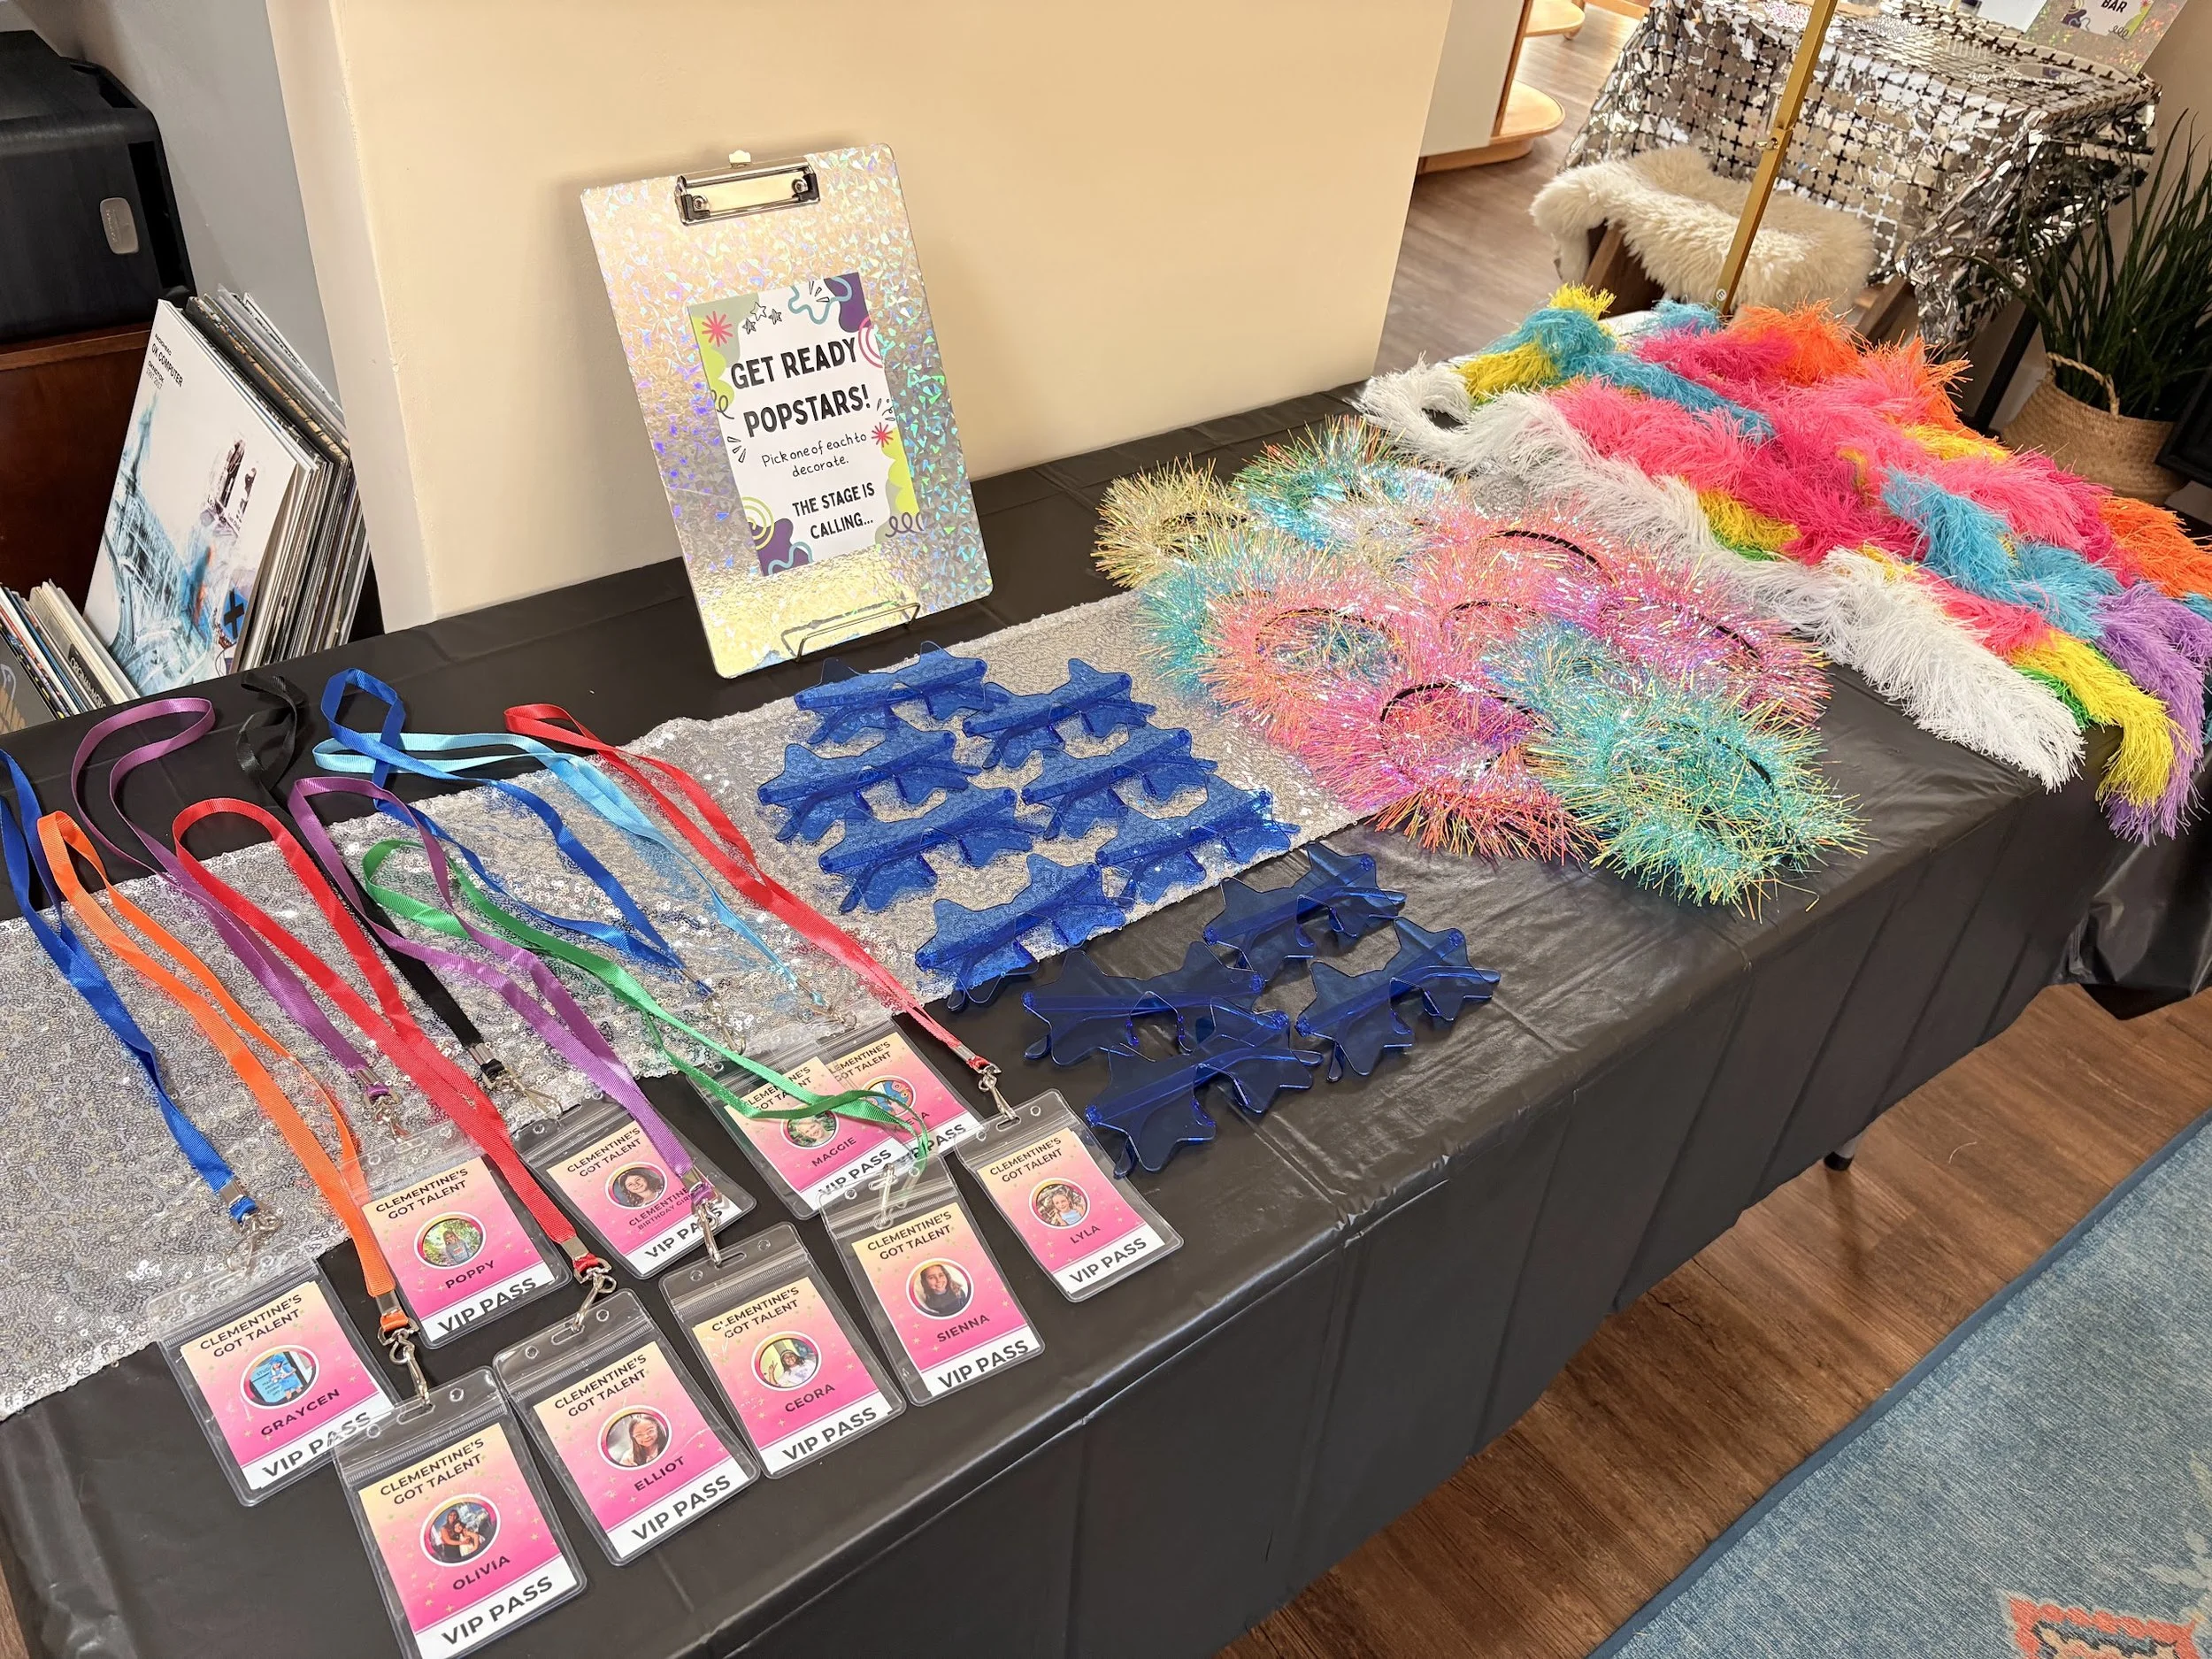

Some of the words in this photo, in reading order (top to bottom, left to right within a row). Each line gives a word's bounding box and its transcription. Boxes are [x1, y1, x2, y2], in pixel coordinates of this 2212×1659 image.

[2101, 0, 2127, 12] BAR
[151, 343, 158, 357] OK
[158, 351, 183, 388] COMPUTER
[731, 356, 774, 389] GET
[780, 337, 856, 379] READY
[743, 384, 871, 438] POPSTARS!
[762, 451, 788, 467] Pick
[790, 448, 810, 459] one
[811, 441, 823, 455] of
[826, 434, 853, 450] each
[855, 433, 867, 443] to
[792, 456, 849, 477] decorate.
[792, 497, 818, 517] THE
[821, 486, 861, 509] STAGE
[862, 482, 875, 497] IS
[810, 512, 873, 539] CALLING...
[828, 1041, 890, 1073] LEMENTINE'S
[855, 1051, 891, 1072] TALENT
[774, 1077, 811, 1101] TANT
[567, 1128, 641, 1172] CLEMENTINE'S
[580, 1162, 602, 1177] GOT
[603, 1138, 641, 1164] TALENT
[811, 1137, 857, 1167] MAGGIE
[849, 1149, 892, 1179] PASS
[990, 1137, 1062, 1176] CLEMENTINE'S
[1002, 1169, 1023, 1182] GOT
[1024, 1148, 1062, 1171] TALENT
[376, 1169, 468, 1212] CLEMENTINE'S
[388, 1202, 415, 1219] GOT
[417, 1180, 466, 1206] TALENT
[629, 1187, 688, 1226] CLEMENTINE
[638, 1205, 675, 1231] BIRTHDAY
[676, 1194, 692, 1206] GIR
[867, 1211, 952, 1250] CLEMENTINE'S
[644, 1238, 675, 1257] VIP
[879, 1244, 905, 1260] GOT
[906, 1225, 951, 1249] TALENT
[1070, 1225, 1100, 1244] LYLA
[445, 1260, 494, 1288] POPPY
[1069, 1263, 1099, 1283] VIP
[1101, 1238, 1147, 1268] PASS
[200, 1294, 302, 1349] CLEMENTINE'S
[437, 1308, 475, 1333] VIP
[480, 1278, 536, 1313] PASS
[724, 1322, 749, 1338] GOT
[751, 1299, 799, 1325] TALENT
[213, 1338, 243, 1357] GOT
[246, 1309, 300, 1341] TALENT
[937, 1314, 990, 1342] SIENNA
[555, 1354, 647, 1409] CLEMENTINE'S
[937, 1364, 972, 1388] VIP
[975, 1340, 1028, 1372] PASS
[261, 1389, 340, 1435] GRAYCEN
[568, 1397, 595, 1417] GOT
[597, 1369, 646, 1401] TALENT
[785, 1384, 835, 1412] CEORA
[262, 1450, 303, 1477] VIP
[309, 1412, 371, 1455] PASS
[782, 1436, 818, 1460] VIP
[822, 1407, 876, 1442] PASS
[380, 1438, 484, 1495] CLEMENTINE'S
[394, 1484, 424, 1504] GOT
[426, 1454, 482, 1487] TALENT
[634, 1455, 685, 1492] ELLIOT
[631, 1511, 670, 1540] VIP
[672, 1475, 731, 1517] PASS
[452, 1555, 511, 1590] OLIVIA
[442, 1616, 484, 1645] VIP
[488, 1576, 553, 1622] PASS
